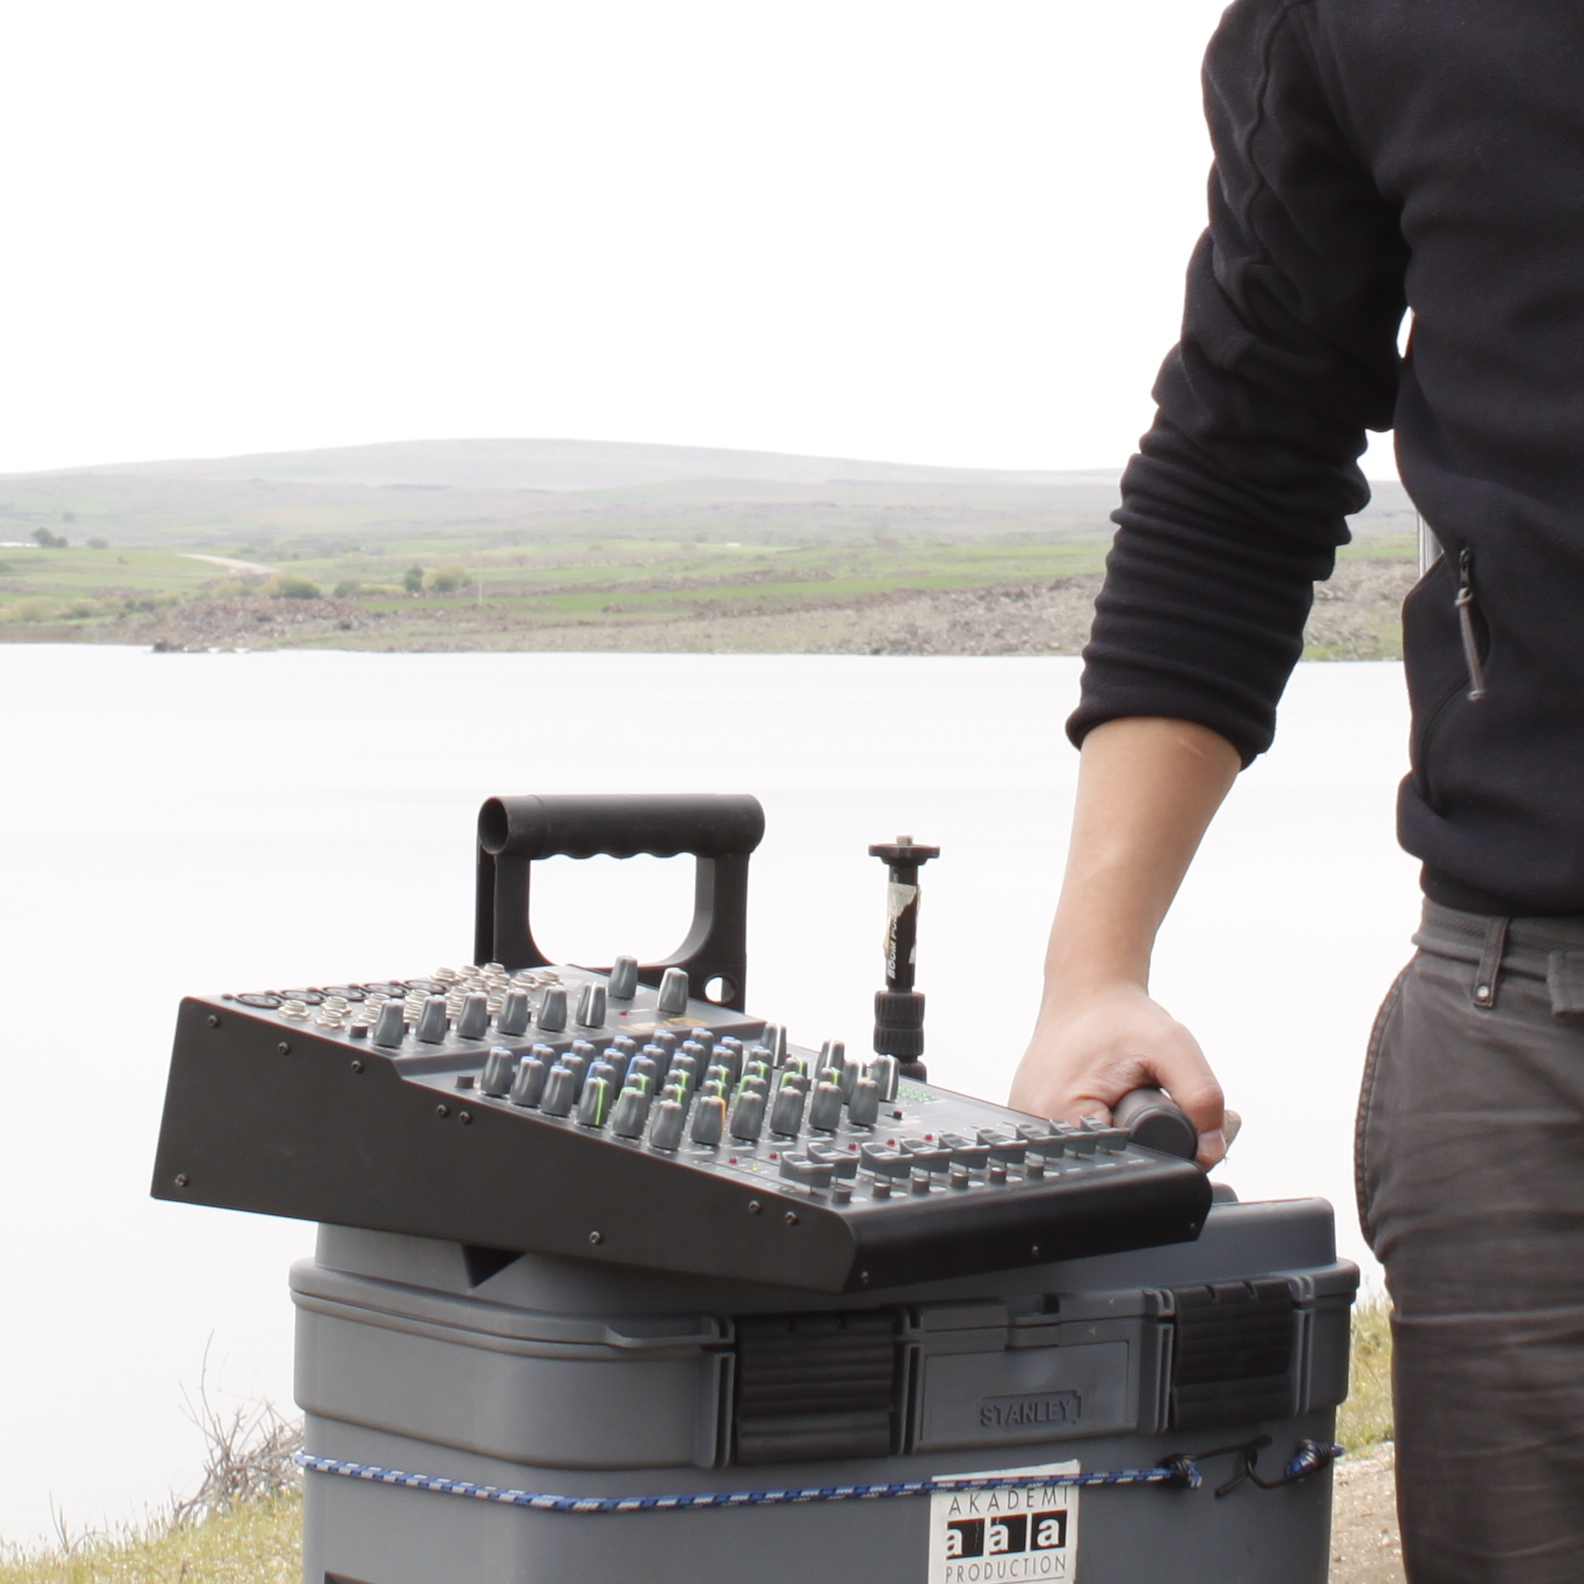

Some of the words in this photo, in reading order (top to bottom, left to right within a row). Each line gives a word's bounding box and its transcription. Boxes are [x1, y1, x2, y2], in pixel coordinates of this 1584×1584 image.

[979, 1399, 1073, 1427] STANLEY
[947, 1486, 1068, 1516] AKADEMI
[945, 1554, 1067, 1584] PRODUCTION
